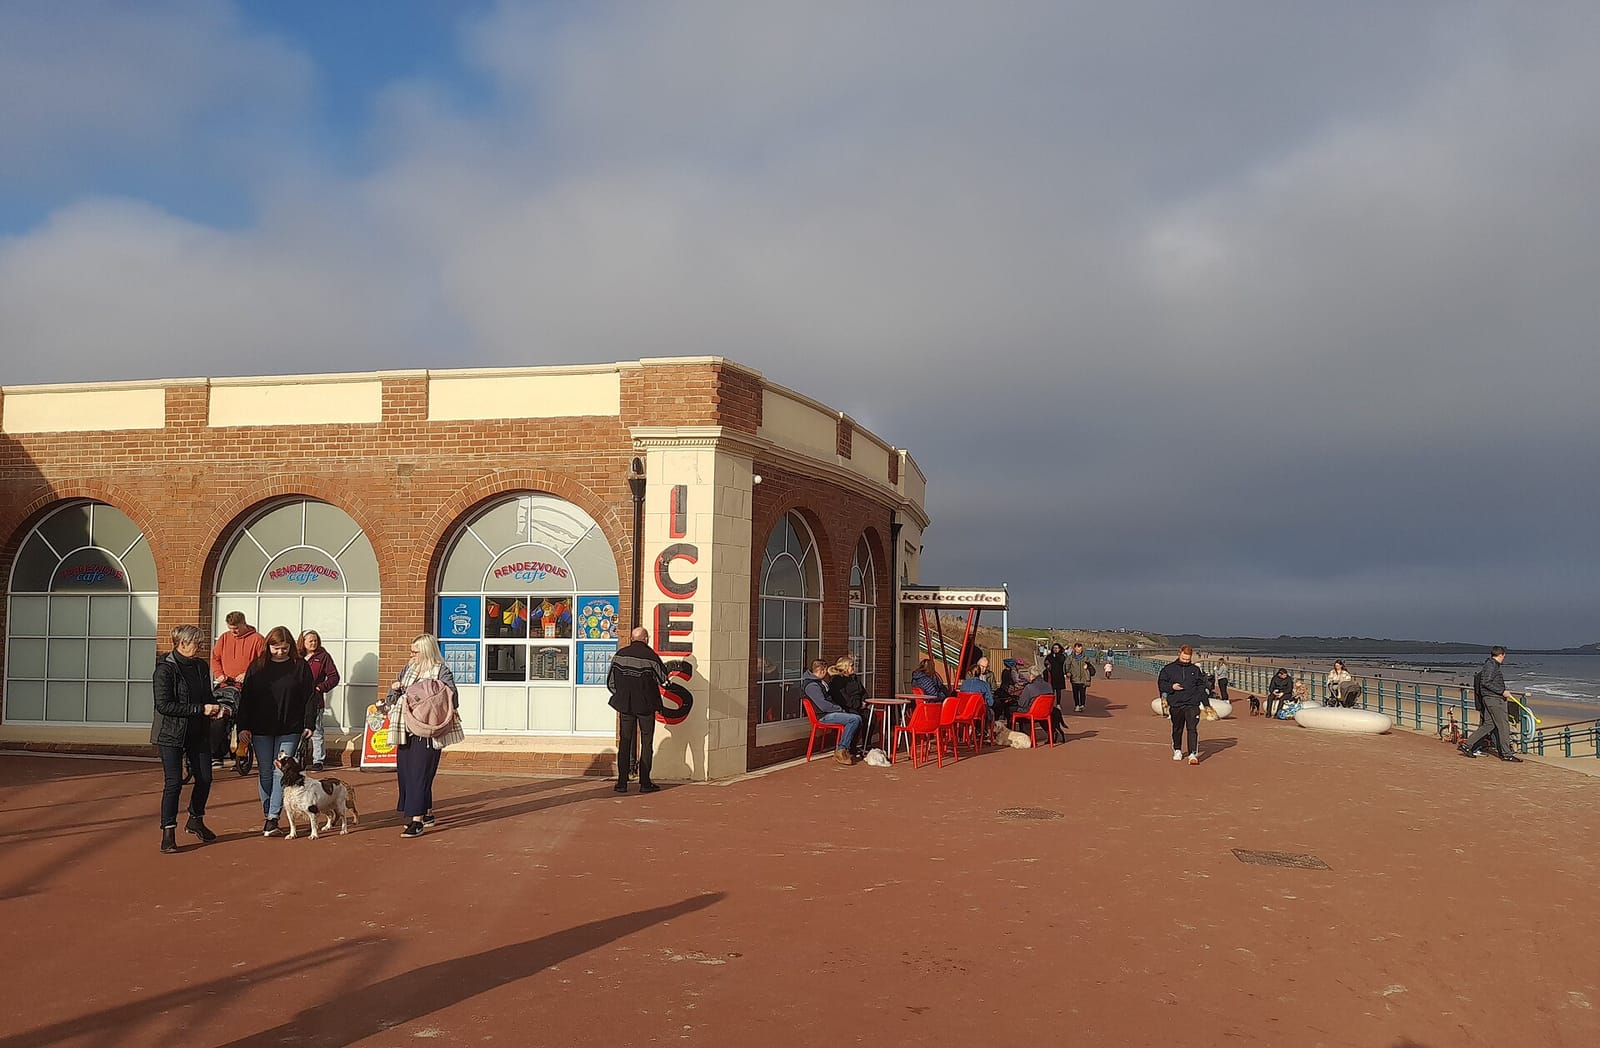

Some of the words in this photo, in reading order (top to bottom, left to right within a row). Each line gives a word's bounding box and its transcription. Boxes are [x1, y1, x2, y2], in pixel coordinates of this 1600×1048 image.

[269, 563, 339, 580] RENDEZVOUS
[494, 561, 569, 579] RENDEZVOUS
[513, 569, 547, 583] cafe
[287, 571, 319, 585] cafe
[902, 592, 932, 601] ices
[958, 593, 1001, 602] coffee
[653, 484, 699, 726] ICES
